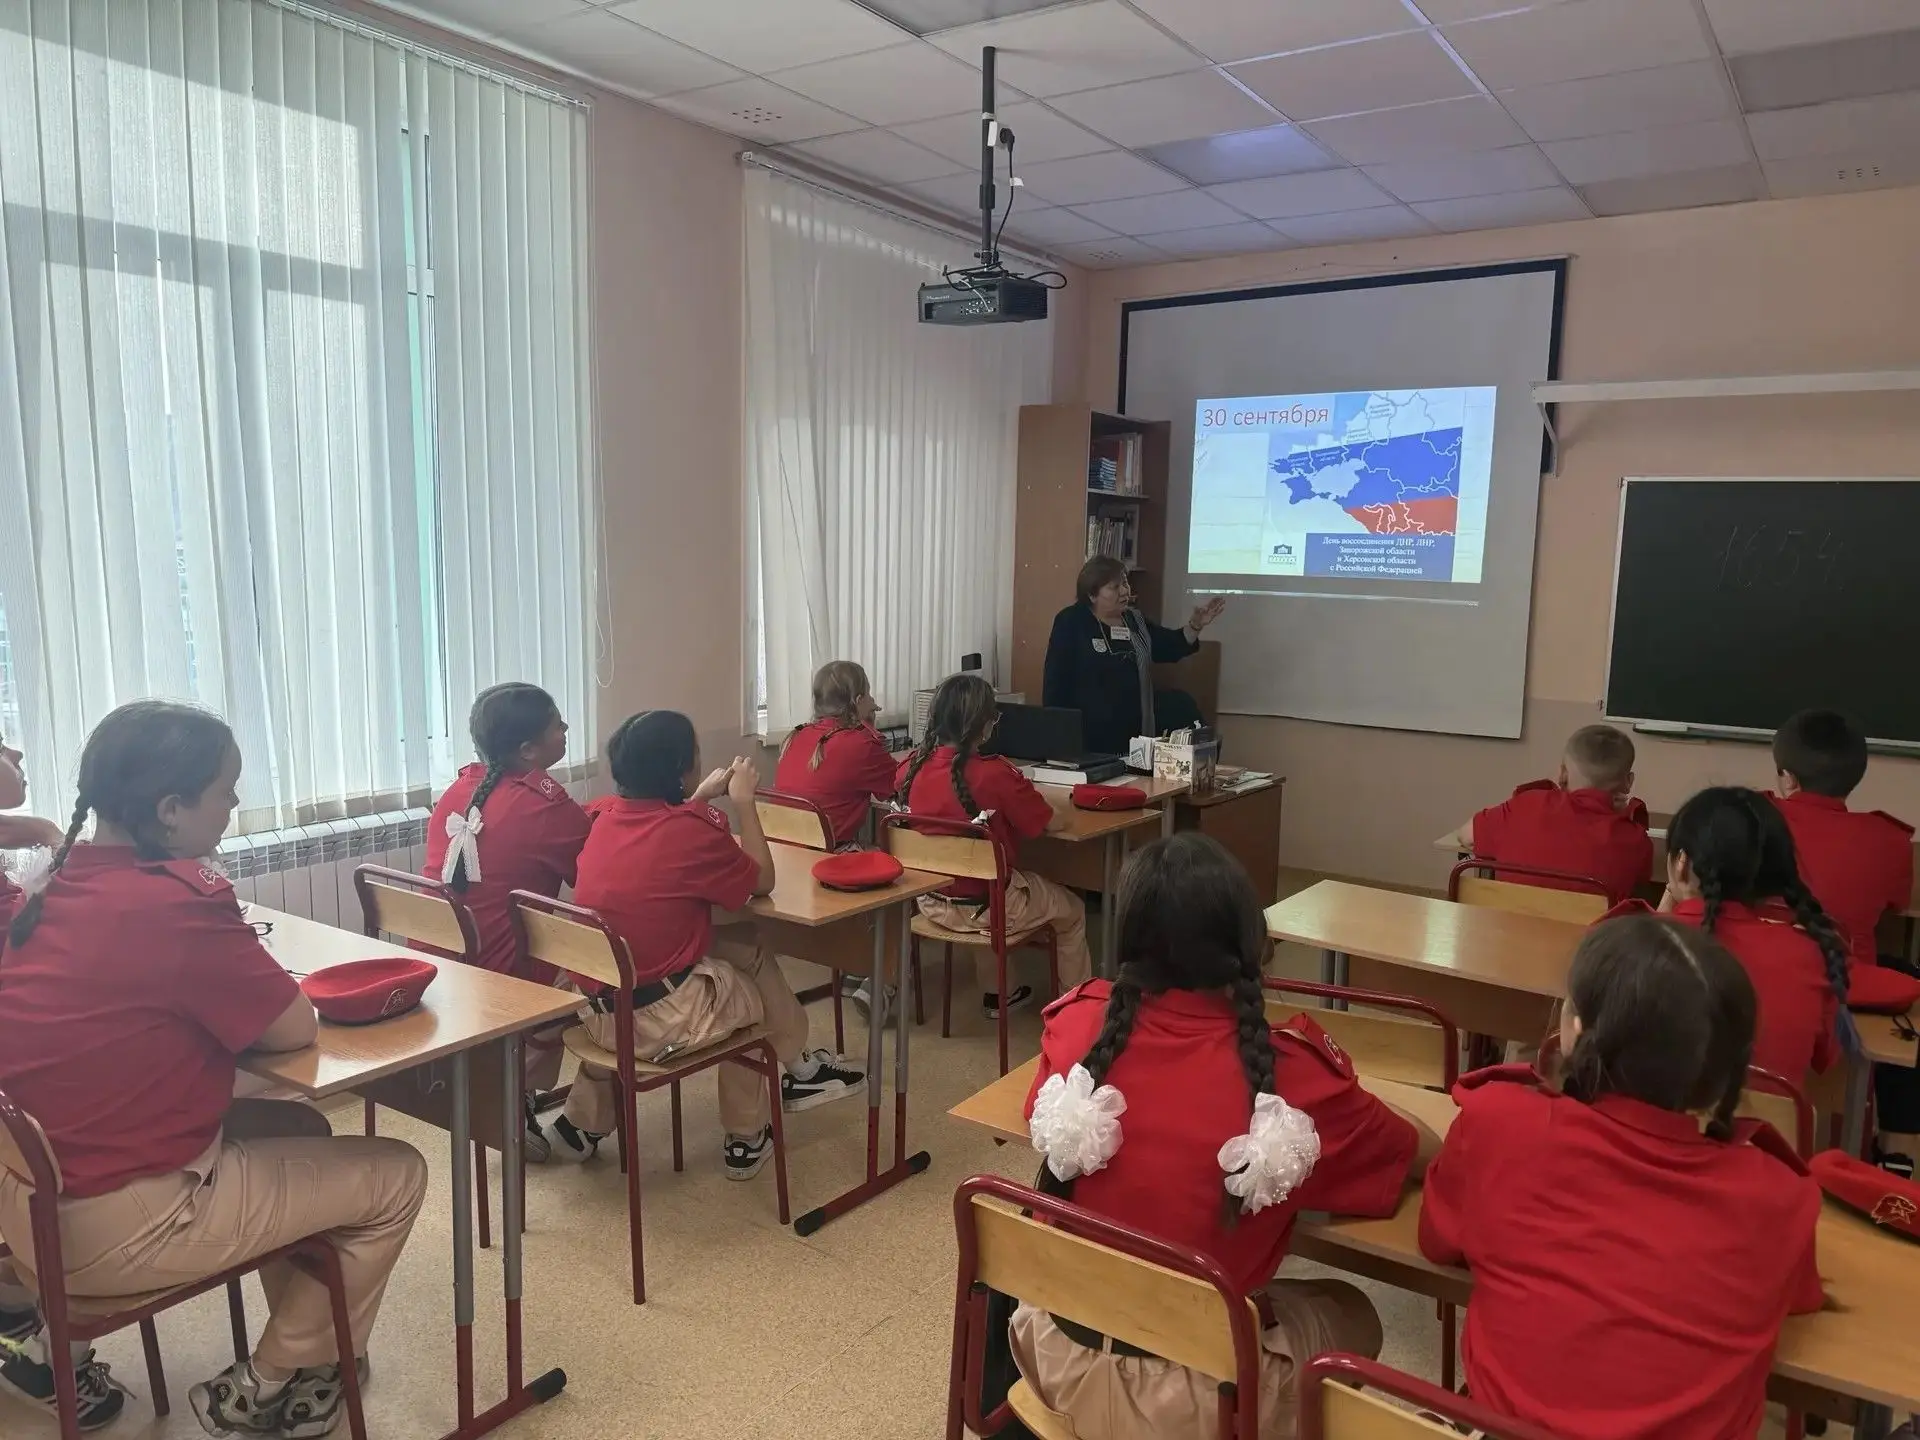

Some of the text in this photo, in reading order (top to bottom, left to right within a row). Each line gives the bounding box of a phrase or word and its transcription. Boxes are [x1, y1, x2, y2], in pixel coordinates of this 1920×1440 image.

[1203, 404, 1328, 428] 30 сентября
[1323, 537, 1340, 545] День
[1386, 546, 1416, 556] области
[1343, 555, 1386, 565] Херсонской
[1387, 556, 1416, 565] области
[1335, 564, 1376, 573] Российской
[1377, 565, 1423, 575] Федерацией
